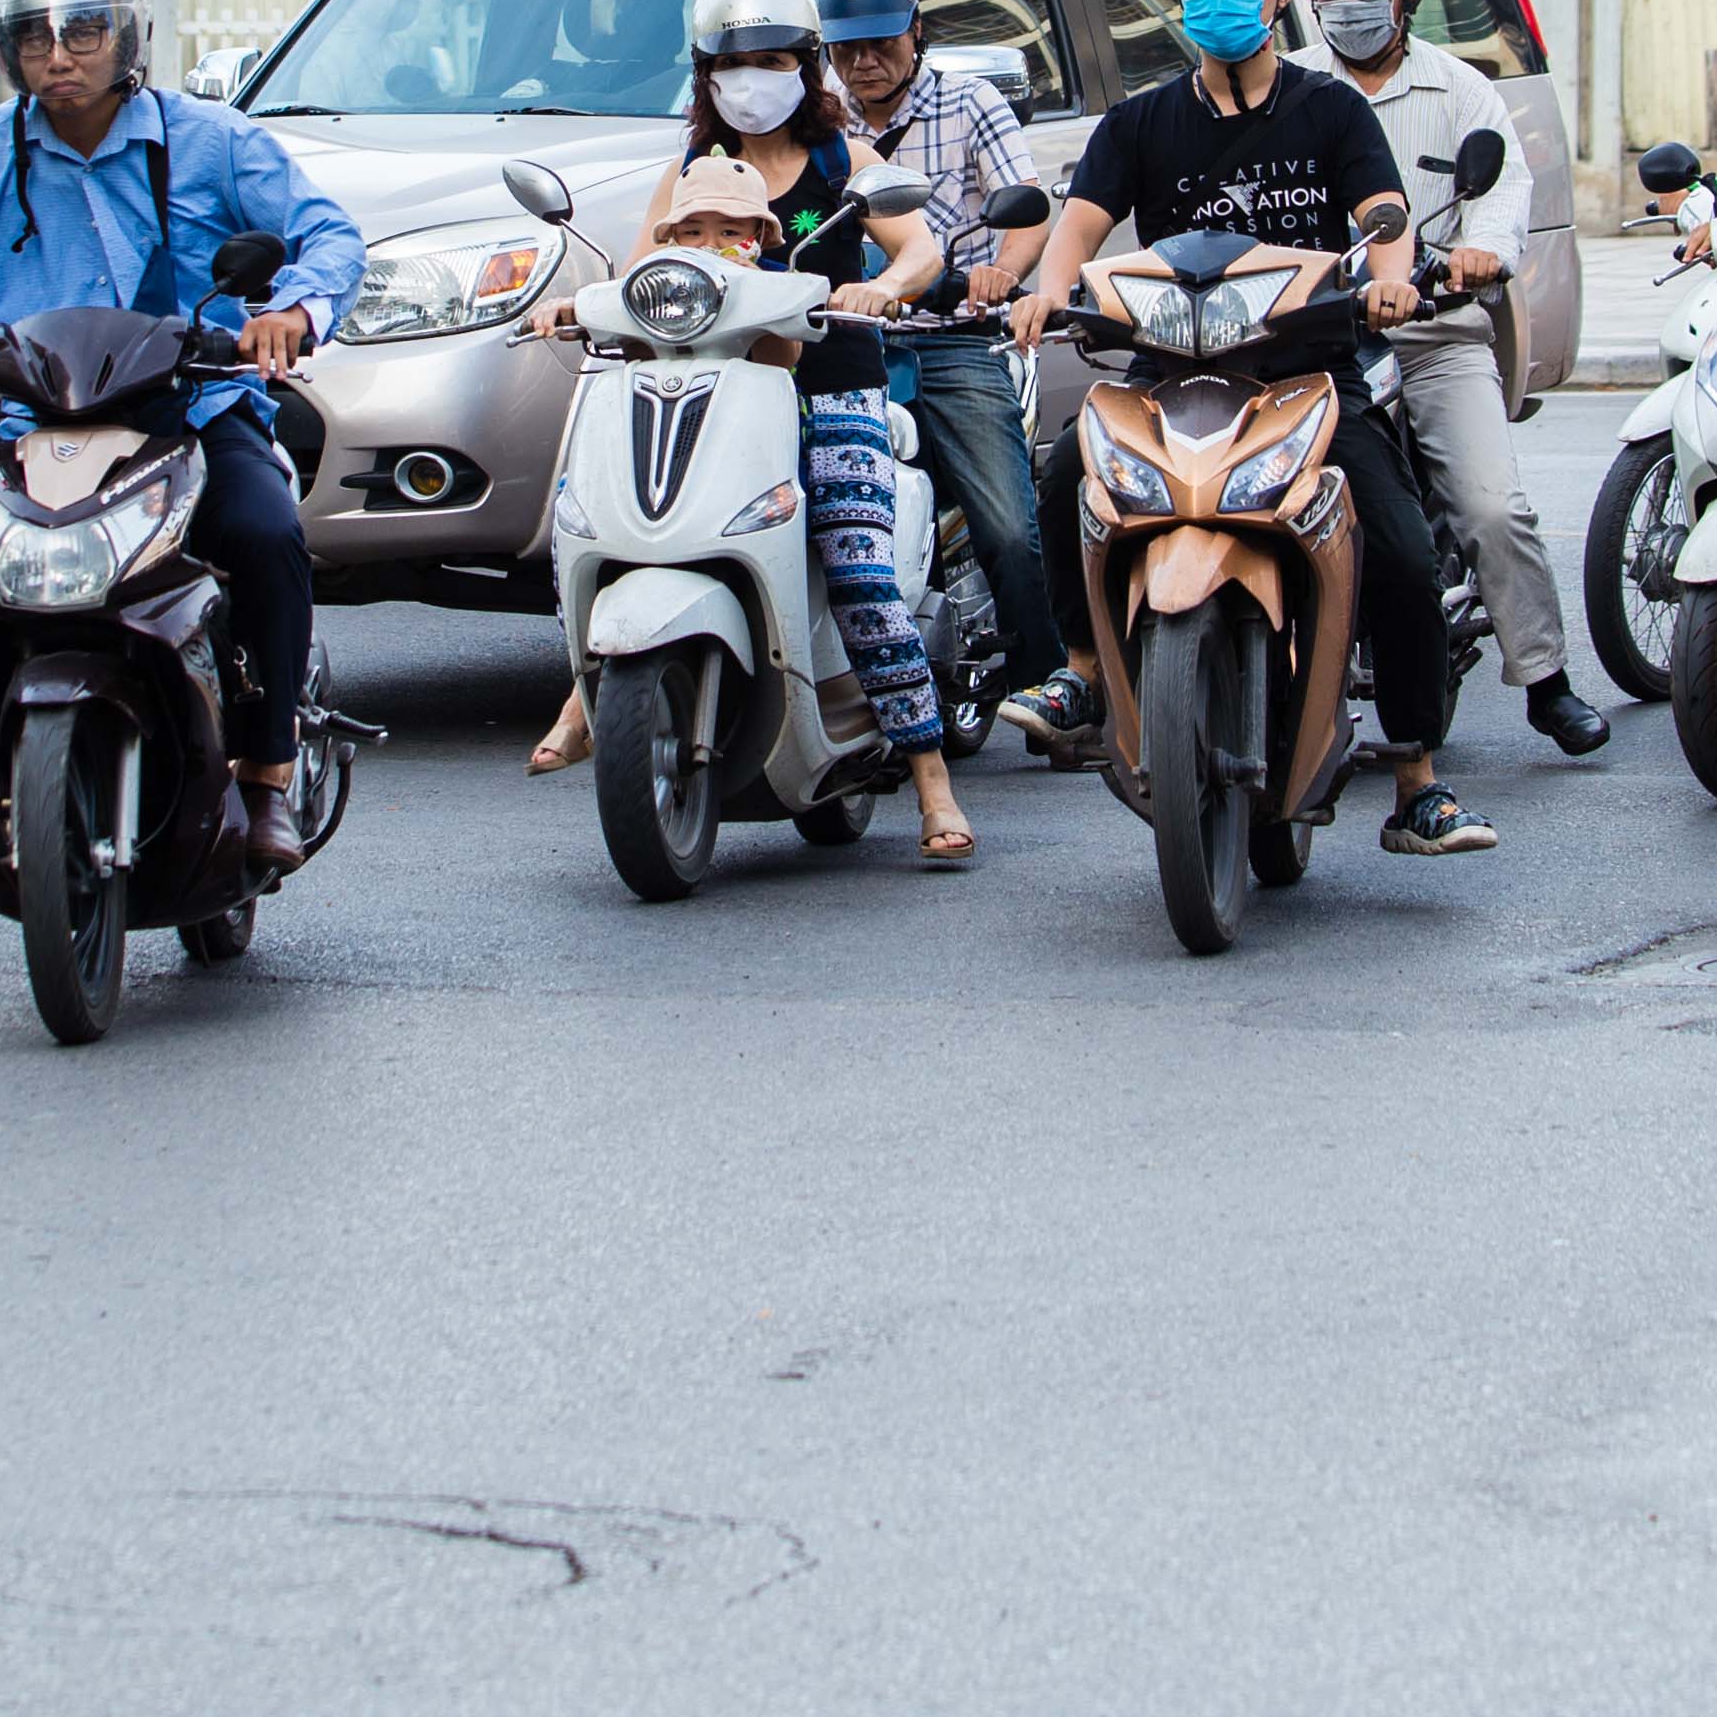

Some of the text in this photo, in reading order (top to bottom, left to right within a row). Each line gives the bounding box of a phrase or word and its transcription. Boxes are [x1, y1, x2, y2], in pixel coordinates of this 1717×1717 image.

[722, 16, 771, 30] HONDA
[1177, 159, 1316, 194] CATIVE
[1180, 374, 1230, 387] HONDA
